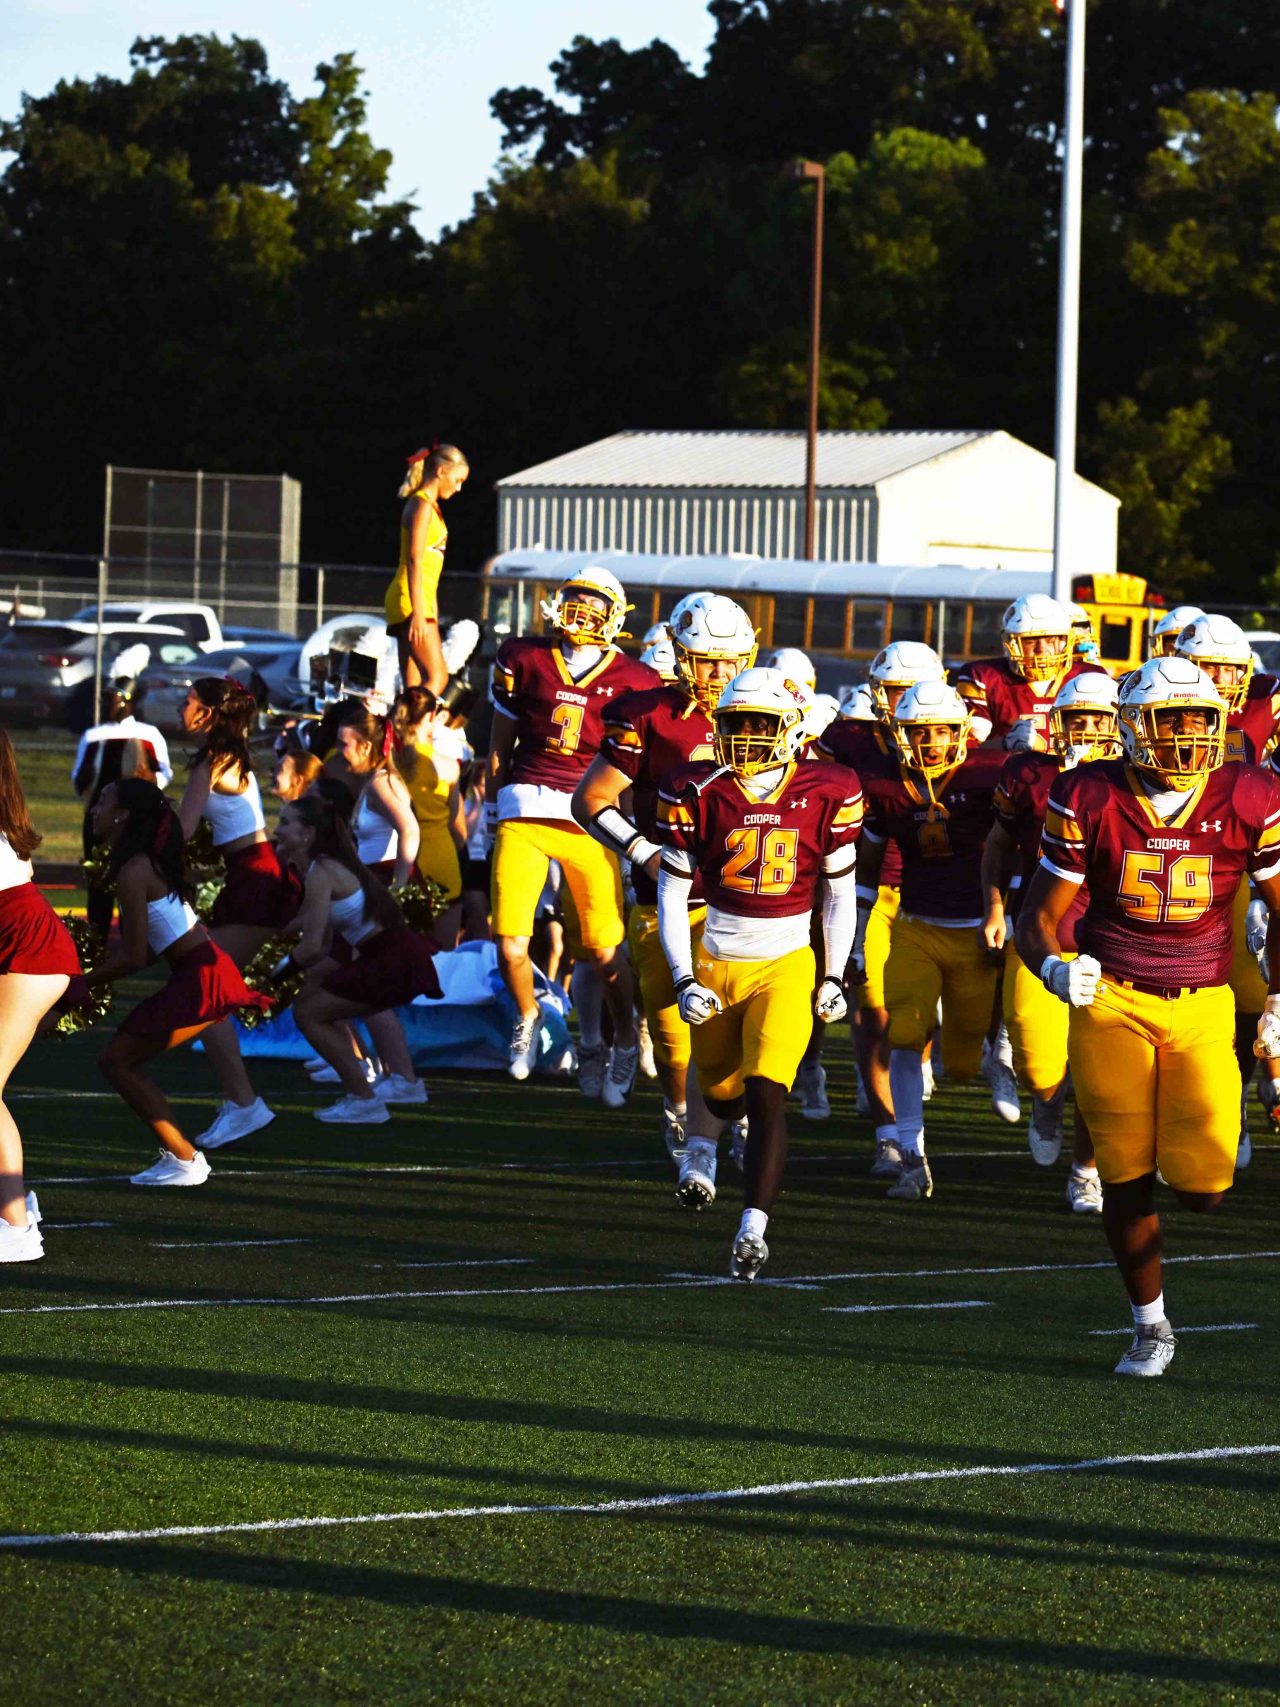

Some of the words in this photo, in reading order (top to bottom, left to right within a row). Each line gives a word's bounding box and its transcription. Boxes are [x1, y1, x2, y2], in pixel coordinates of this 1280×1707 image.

[555, 690, 588, 706] COOPER
[545, 702, 585, 756] 3
[743, 813, 781, 825] COOPER
[720, 827, 800, 897] 28
[1146, 838, 1191, 851] COOPER
[1116, 850, 1213, 923] 59
